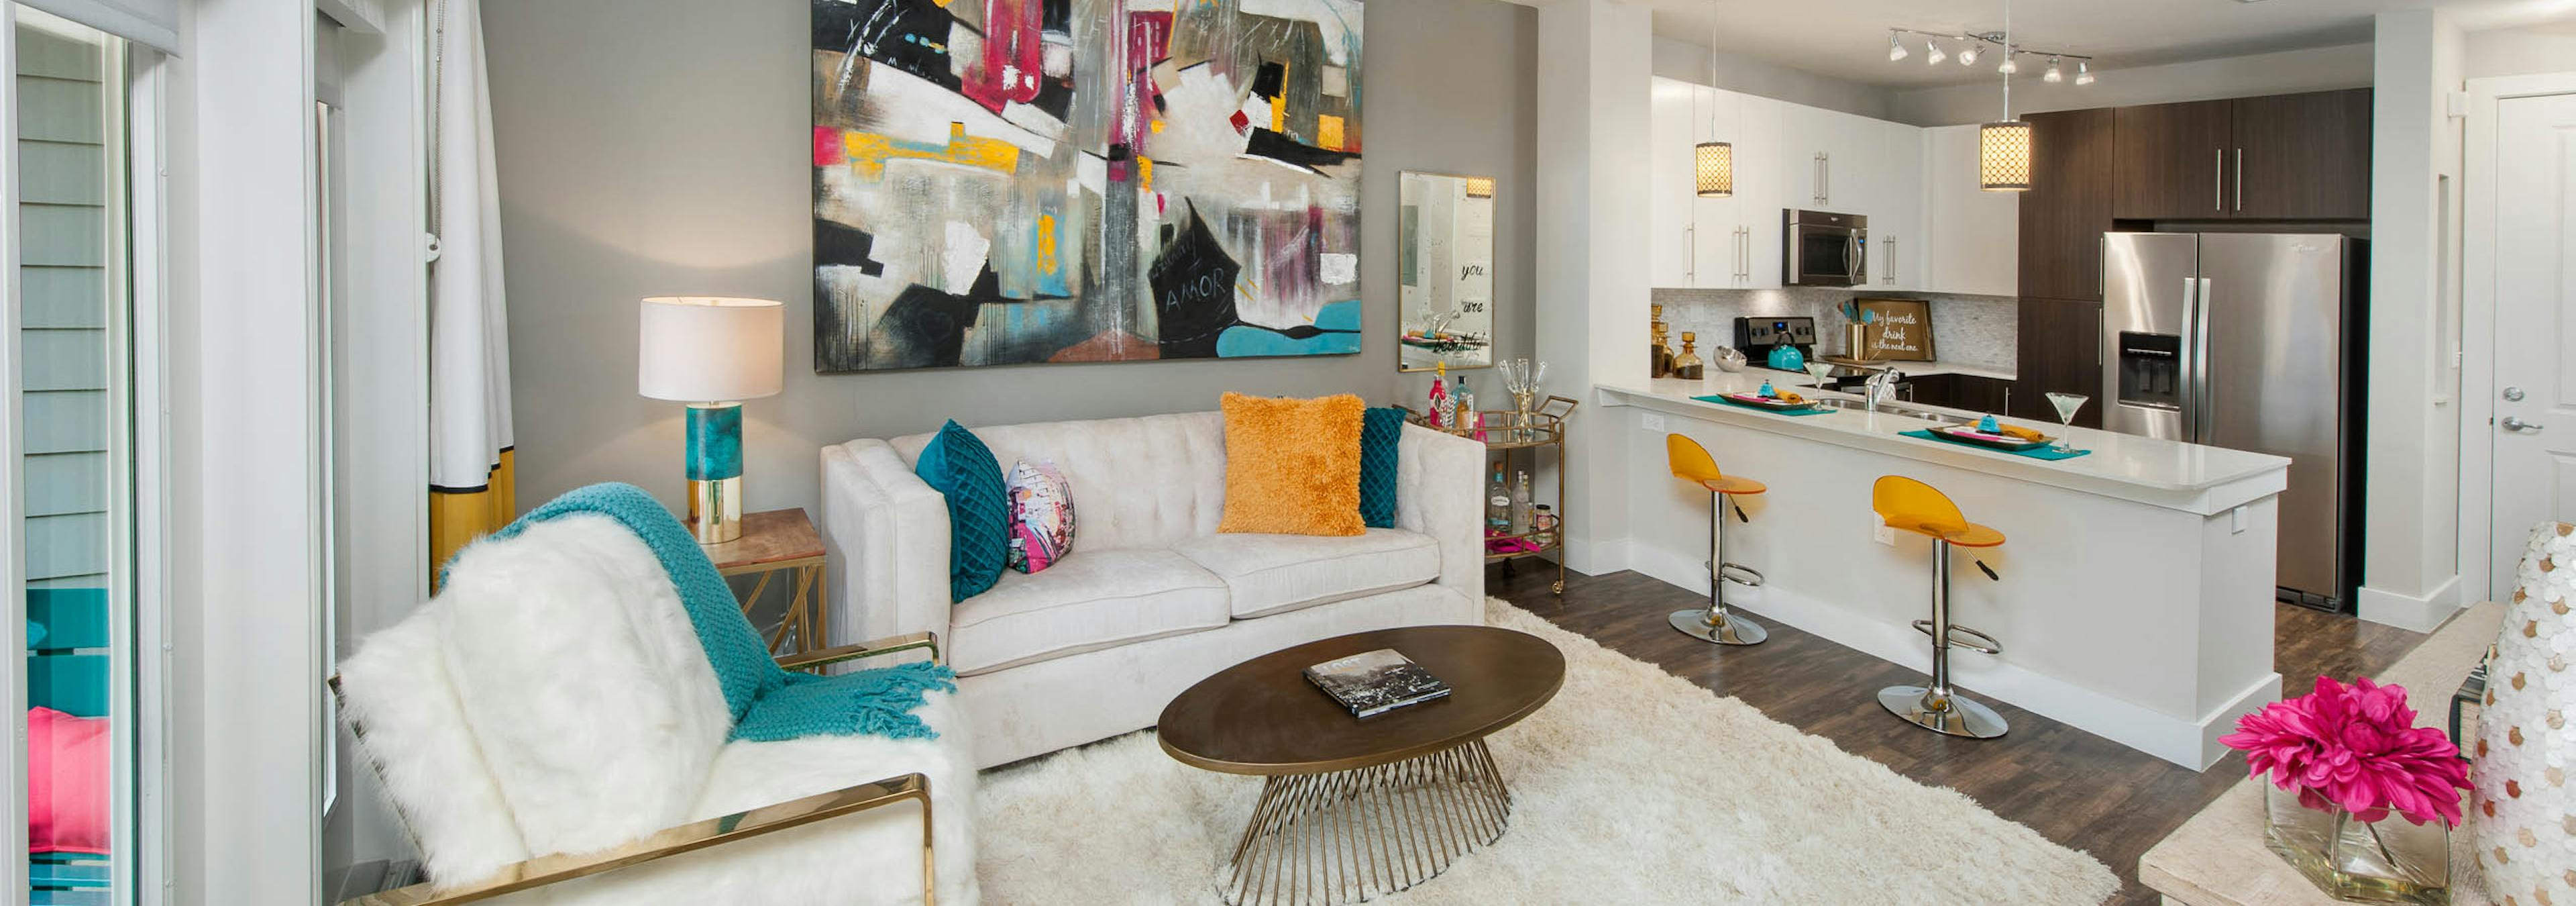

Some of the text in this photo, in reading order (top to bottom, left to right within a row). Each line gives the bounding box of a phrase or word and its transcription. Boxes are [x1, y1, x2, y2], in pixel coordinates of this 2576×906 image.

[1461, 265, 1483, 281] you
[1166, 268, 1226, 311] AMOR
[1886, 310, 1917, 325] favorite
[1883, 325, 1906, 341] drink
[1879, 338, 1890, 349] the
[1891, 341, 1905, 350] next
